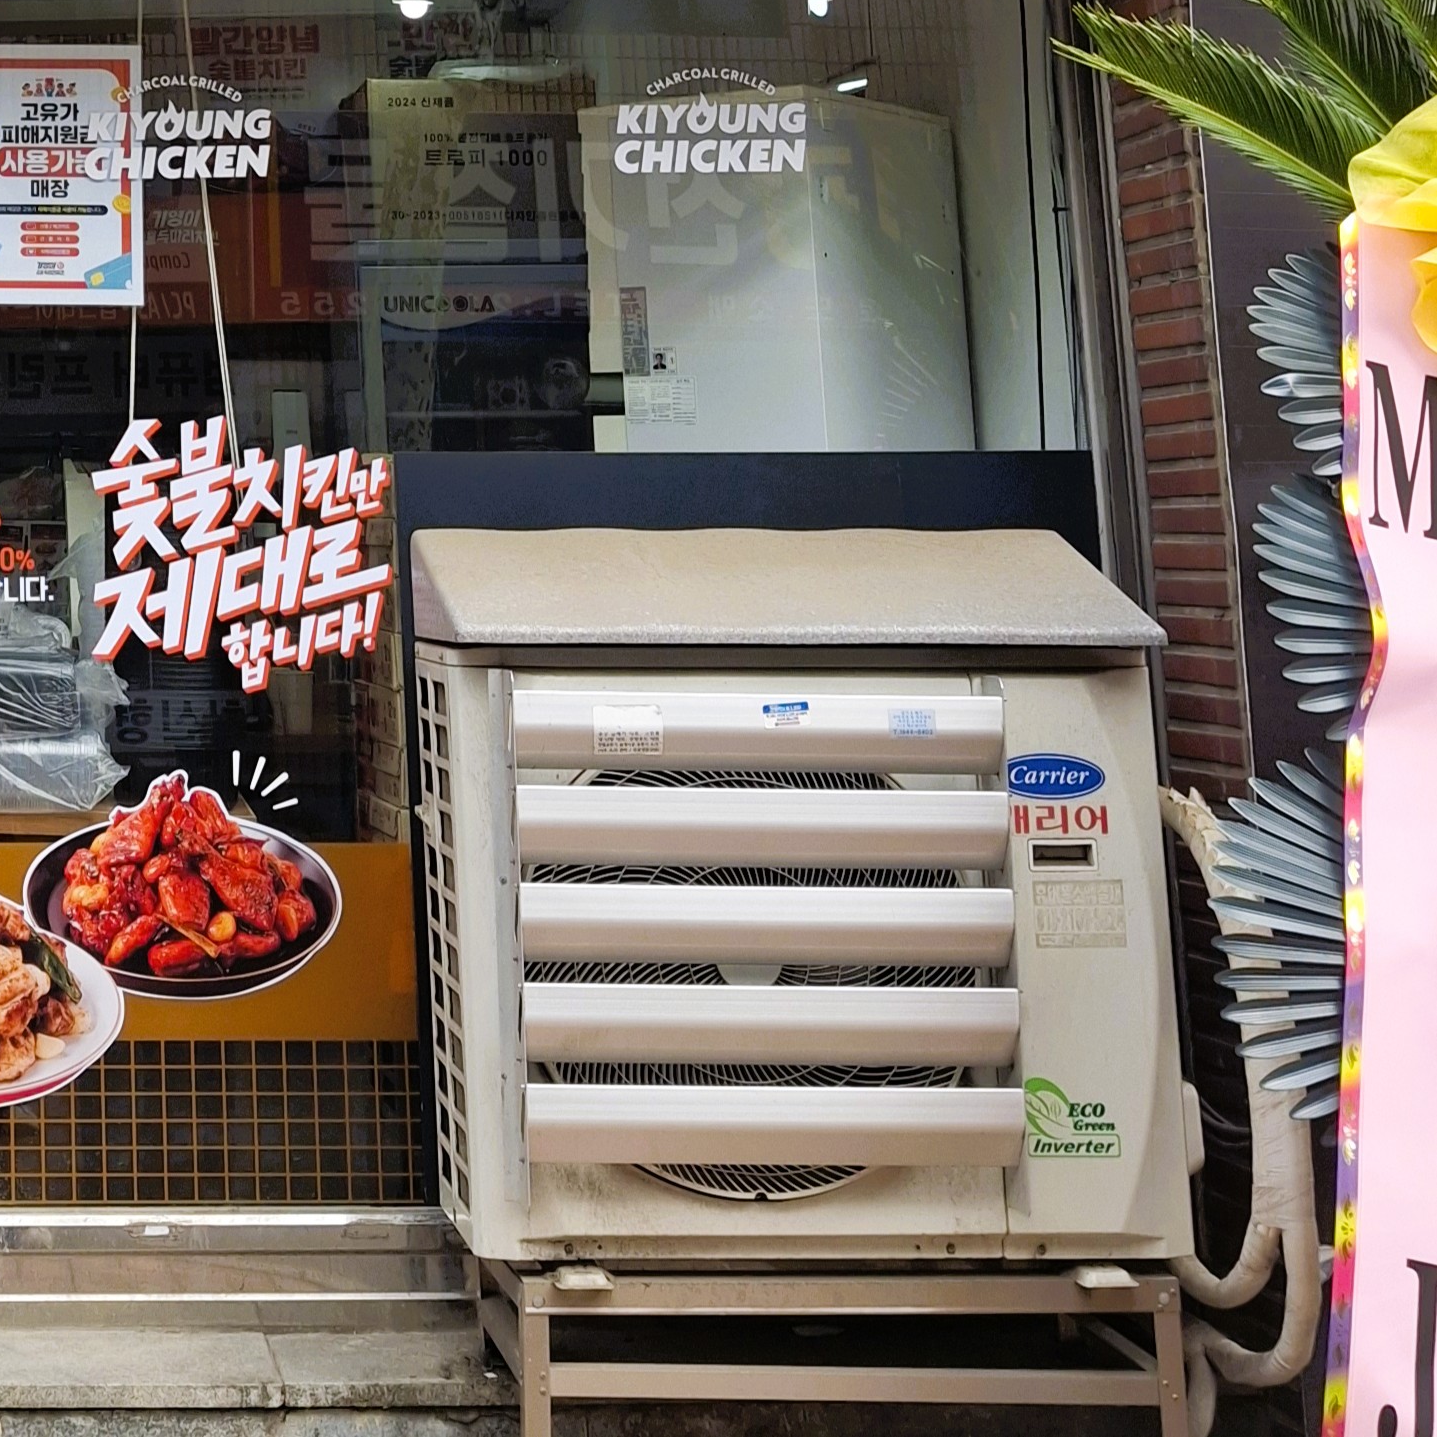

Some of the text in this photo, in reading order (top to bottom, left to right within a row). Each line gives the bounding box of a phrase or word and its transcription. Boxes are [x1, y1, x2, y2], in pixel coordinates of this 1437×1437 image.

[116, 75, 187, 105] CHARCOAL
[188, 75, 243, 105] GRILLED
[645, 67, 777, 97] CHARCOAL GRILLED
[20, 103, 80, 122] 고유가
[387, 97, 417, 107] 2024
[615, 91, 807, 136] KIYOUNG
[88, 98, 271, 143] KIYOUNG
[85, 146, 270, 182] CHICKEN
[613, 138, 806, 174] CHICKEN
[30, 179, 70, 198] 매장
[91, 415, 391, 571] 숯불치킨만
[92, 518, 393, 662] 제대로
[221, 591, 384, 695] 합니다!
[1010, 765, 1089, 785] Carrier
[1067, 1102, 1106, 1118] ECO
[1073, 1119, 1116, 1131] Green
[1033, 1138, 1116, 1153] Inverter
